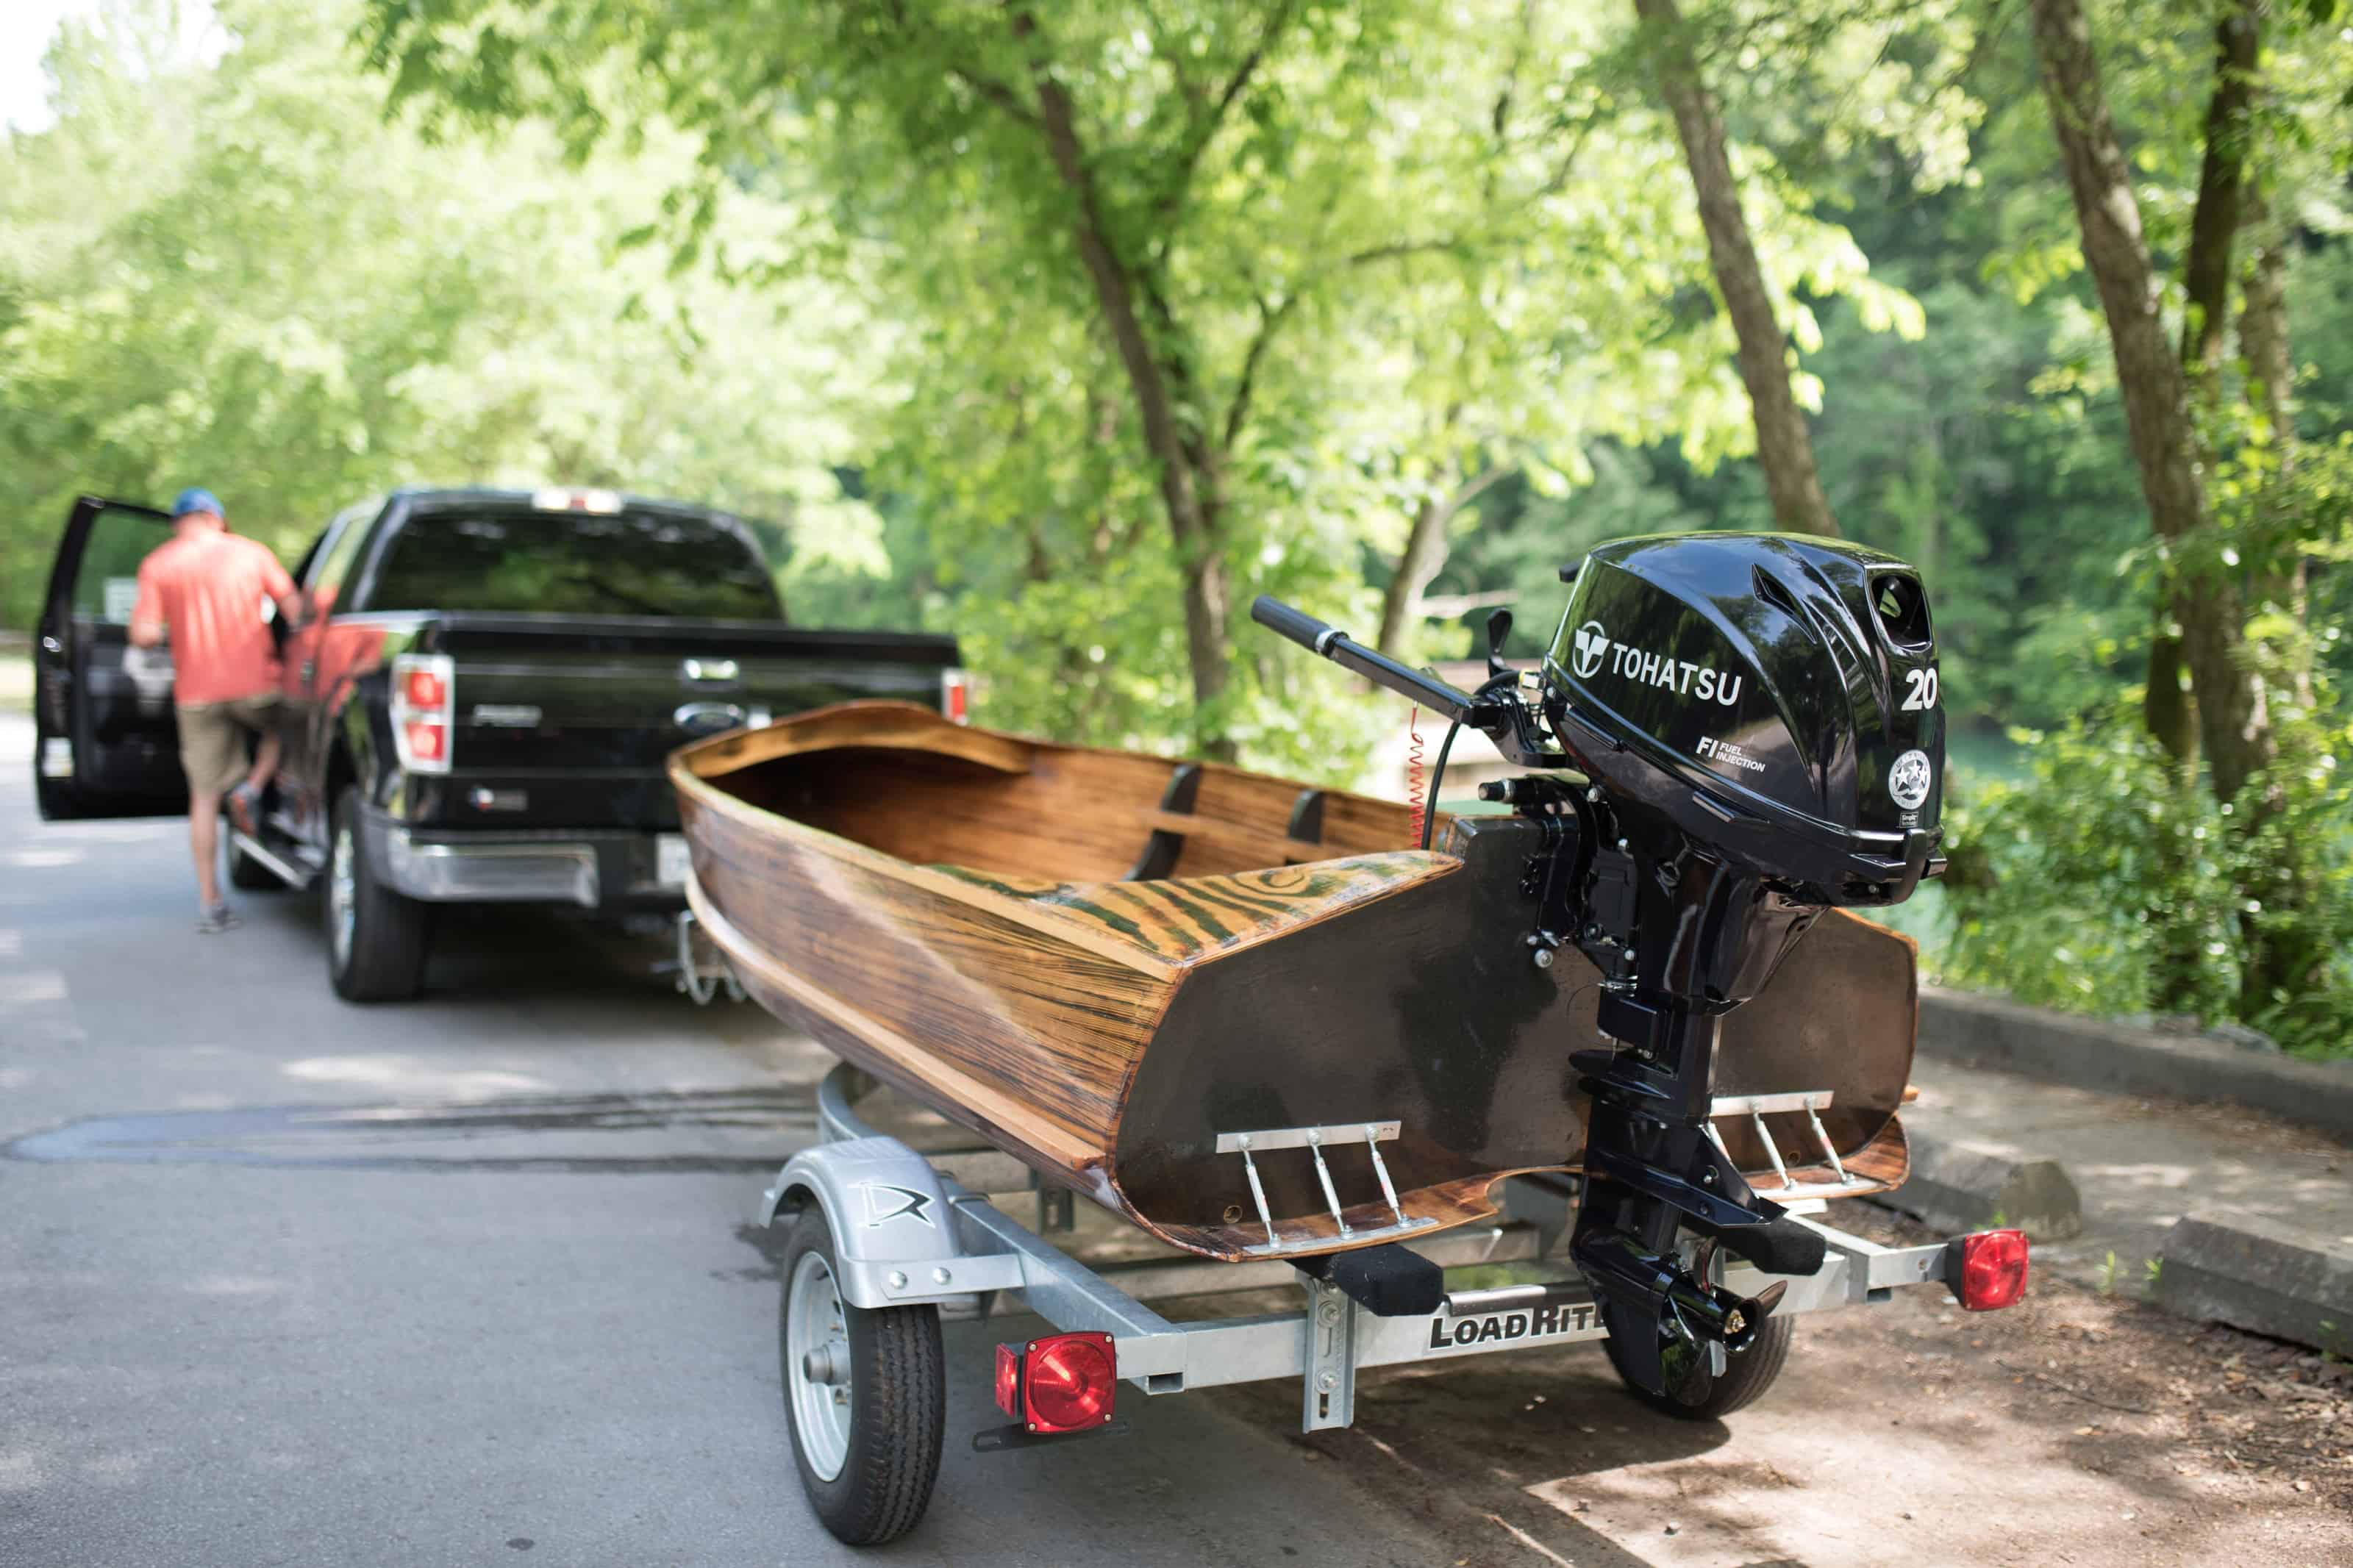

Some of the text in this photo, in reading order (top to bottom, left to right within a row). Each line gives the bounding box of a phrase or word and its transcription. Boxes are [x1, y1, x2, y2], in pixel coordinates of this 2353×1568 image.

[1613, 642, 1742, 706] TOHATSU
[1901, 667, 1938, 711] 20
[1696, 736, 1719, 758] FI
[1719, 742, 1742, 756] FUEL
[1715, 751, 1765, 773] INJECTION
